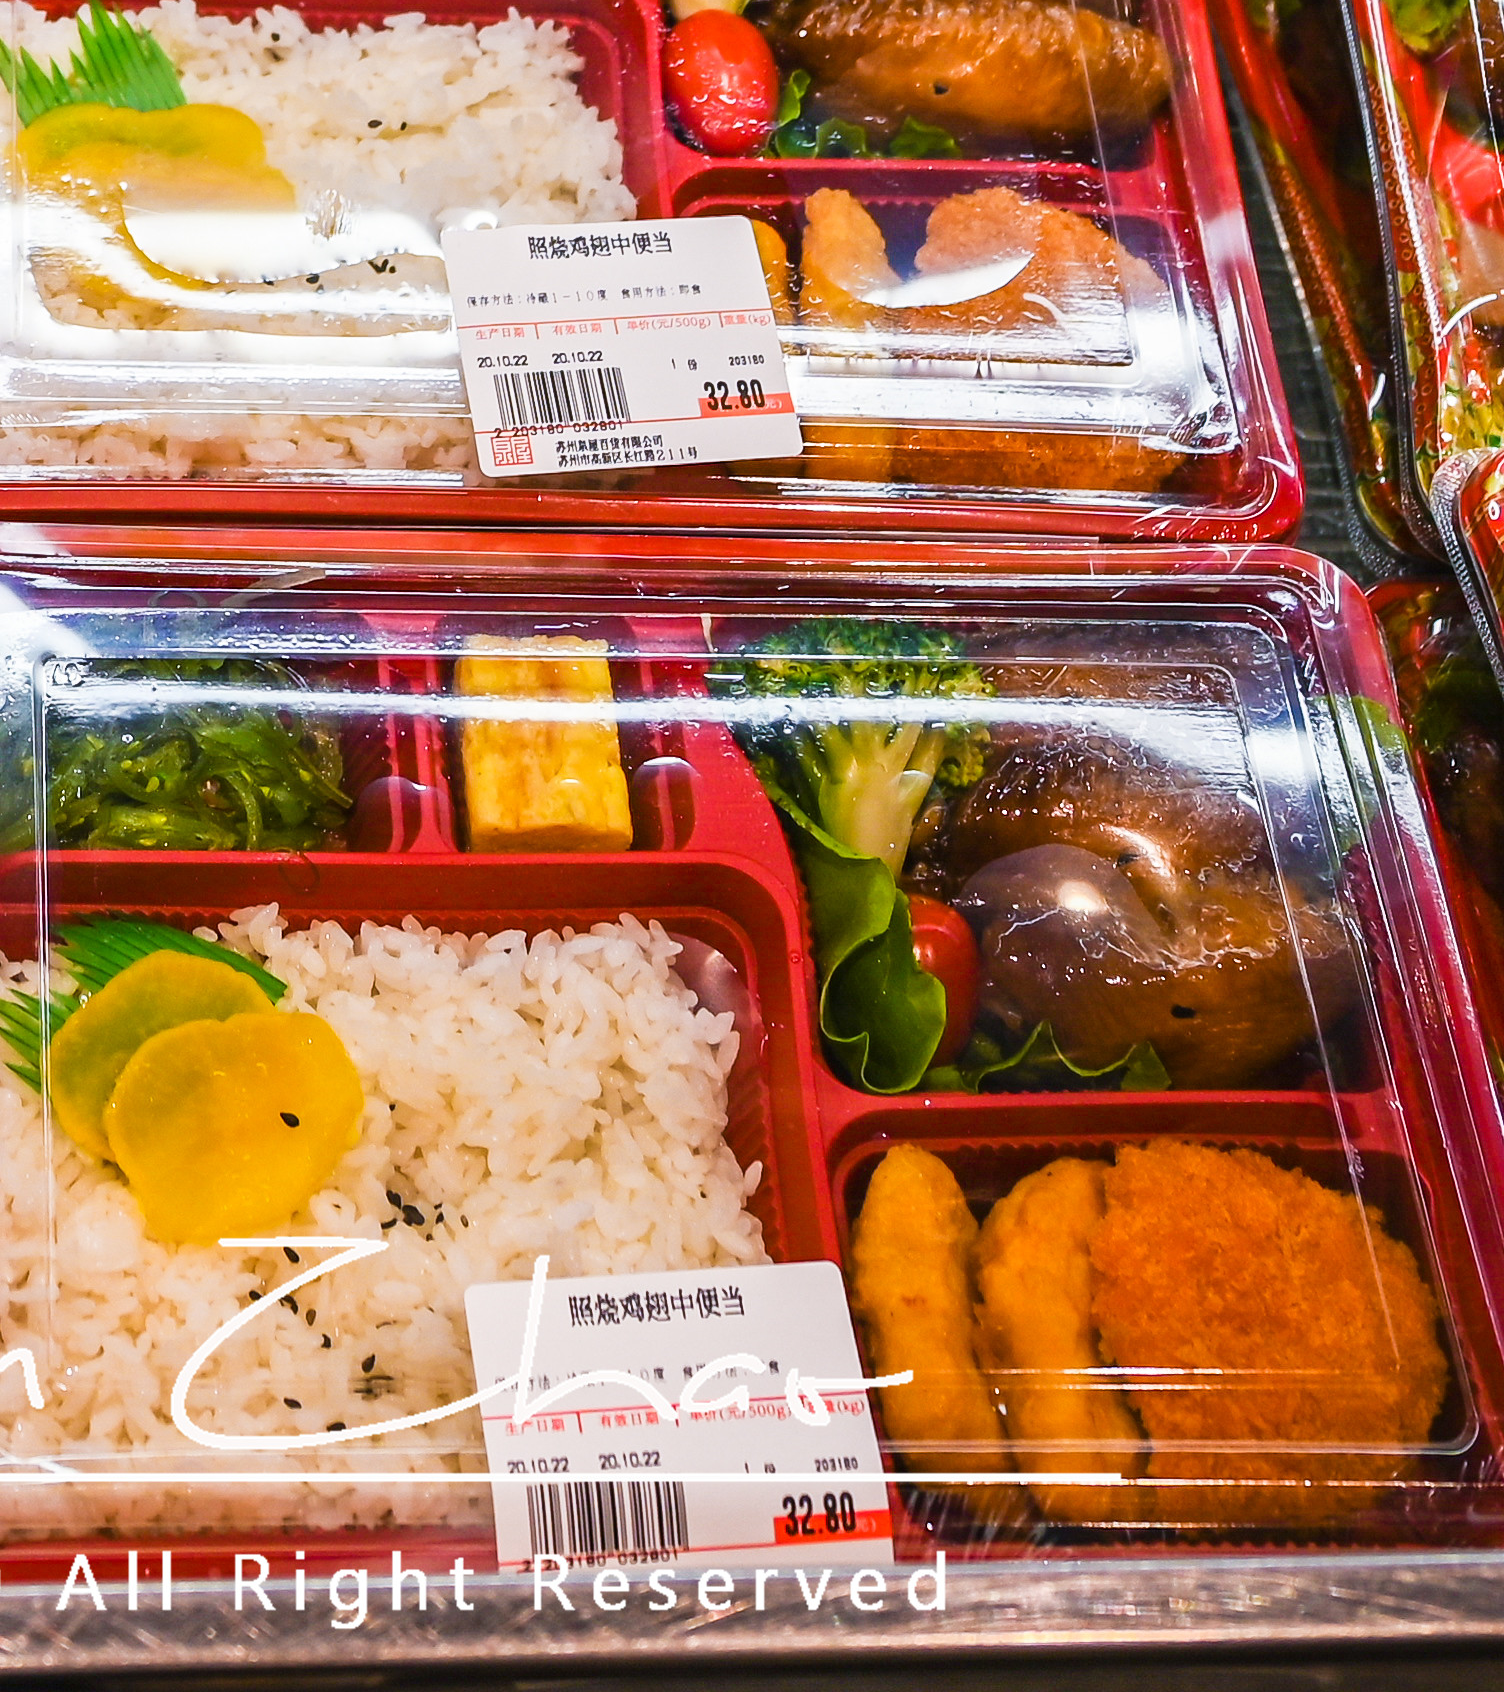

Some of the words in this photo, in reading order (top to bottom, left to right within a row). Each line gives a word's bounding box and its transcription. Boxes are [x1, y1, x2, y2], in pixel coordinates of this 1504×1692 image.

[528, 231, 672, 260] 照烧鸡翅中便当
[475, 327, 525, 340] 生产日期
[552, 322, 602, 336] 有效日期
[477, 354, 528, 369] 20.10.22
[552, 350, 603, 364] 20.10.22
[729, 355, 764, 366] 203180
[703, 378, 765, 412] 32.80
[568, 1284, 745, 1327] 照烧鸡翅中便当
[507, 1456, 570, 1474] 20.10.22
[598, 1450, 660, 1470] 20.10.22
[782, 1490, 857, 1537] 32.80
